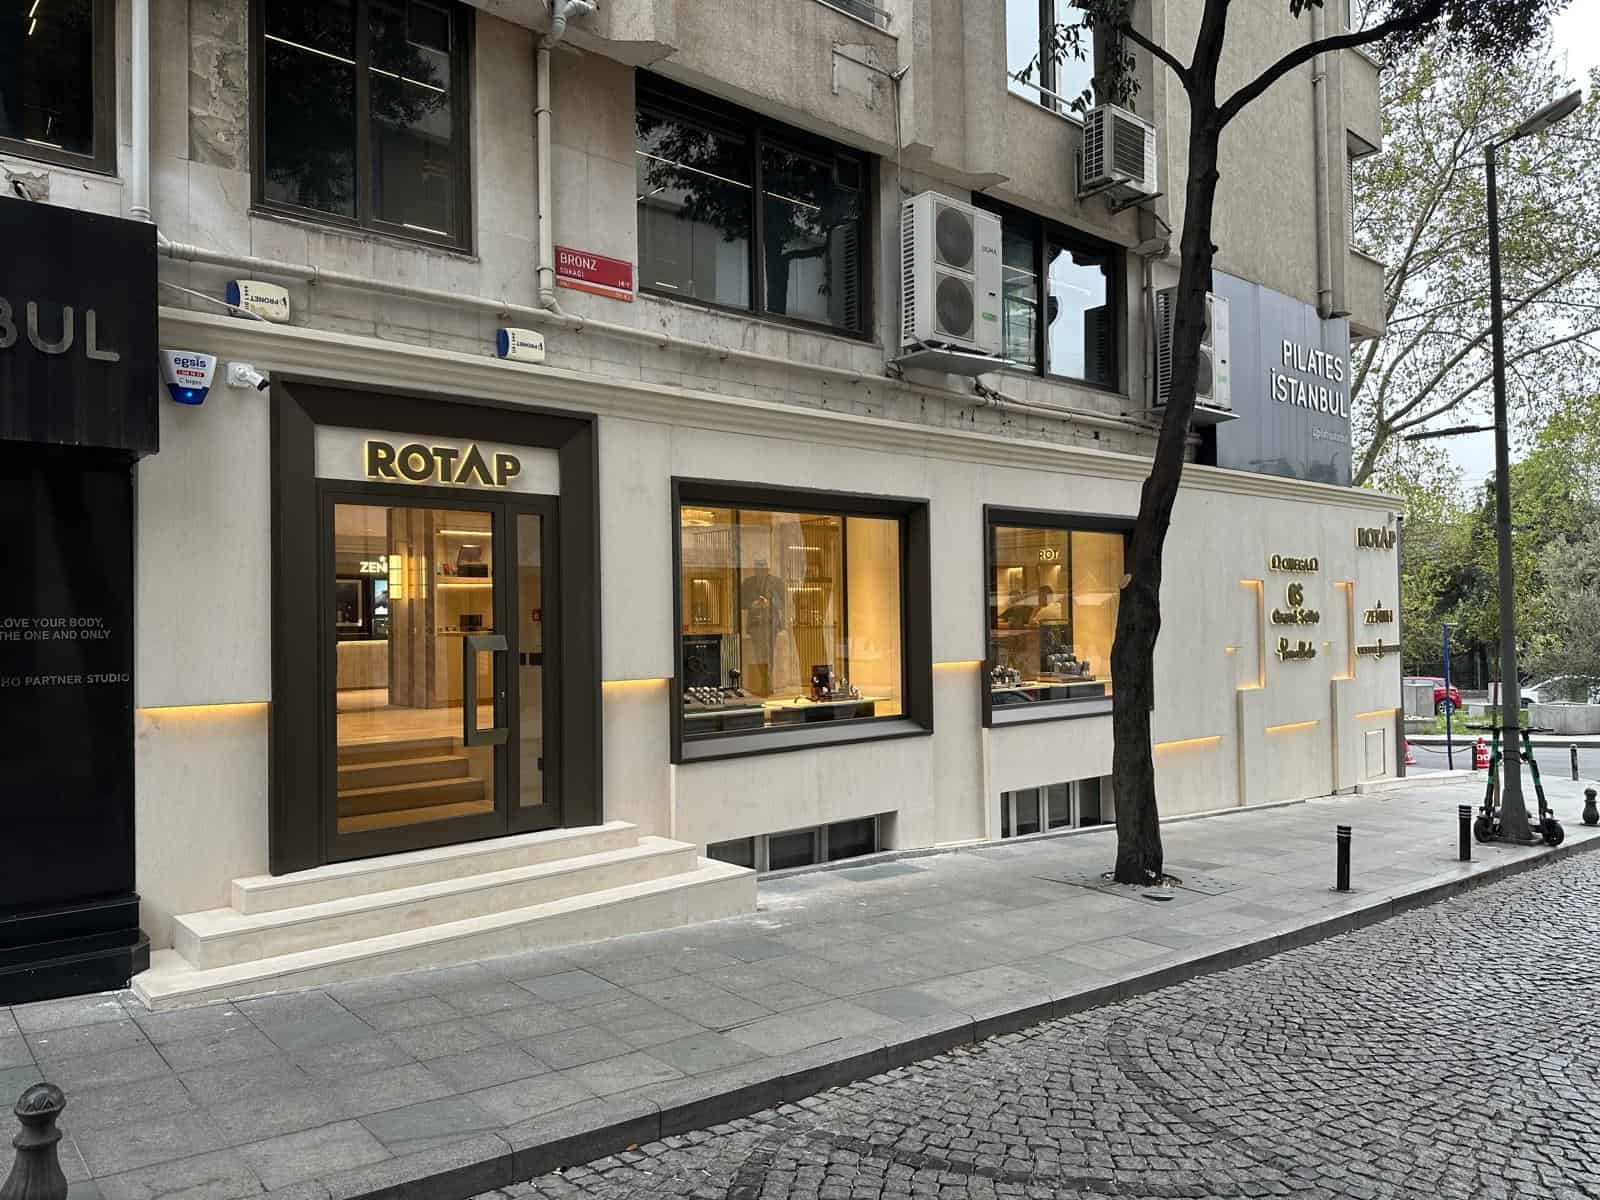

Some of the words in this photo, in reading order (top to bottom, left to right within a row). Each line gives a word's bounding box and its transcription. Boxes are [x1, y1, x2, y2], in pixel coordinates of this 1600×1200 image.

[560, 252, 598, 271] BRONZ
[174, 357, 207, 368] egsis
[1282, 338, 1344, 383] PILATES
[366, 440, 521, 487] ROTAP
[33, 617, 66, 628] YOUR
[69, 616, 104, 629] BODY,
[24, 630, 49, 640] ONE
[53, 630, 77, 640] AND
[81, 629, 112, 639] ONLY
[25, 674, 82, 686] PARTNER
[87, 673, 130, 684] STUDIO
